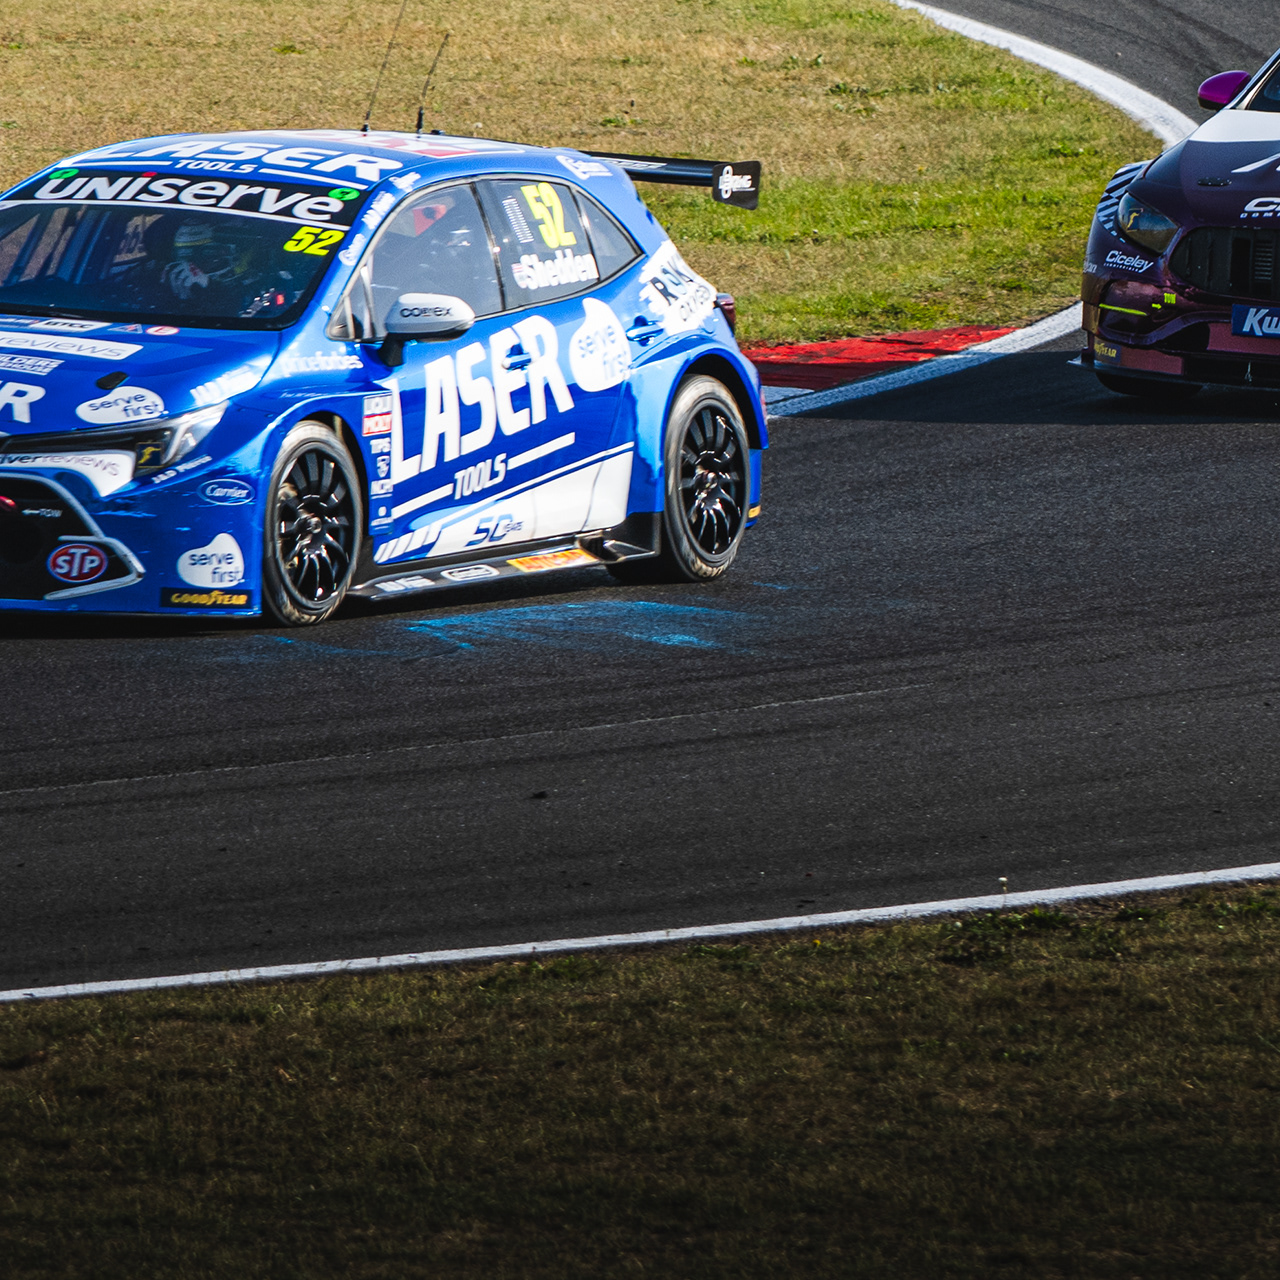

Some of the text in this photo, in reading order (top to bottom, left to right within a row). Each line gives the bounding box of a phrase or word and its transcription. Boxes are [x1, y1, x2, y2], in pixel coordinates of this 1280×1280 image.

[78, 140, 404, 183] LASER
[175, 158, 261, 174] TOOLS
[521, 182, 577, 249] 52
[283, 225, 345, 256] 52
[519, 248, 600, 290] Shedden
[1105, 250, 1154, 272] Ciceley
[43, 320, 95, 329] BTCC
[577, 323, 618, 360] serve
[87, 392, 147, 412] serve
[386, 315, 575, 484] LASER
[454, 452, 508, 501] TOOLS
[205, 484, 250, 500] Carrier
[39, 508, 63, 518] TOW
[465, 514, 513, 547] 50
[54, 547, 100, 577] STP
[188, 552, 235, 566] serve
[170, 590, 248, 606] GOODYEAR
